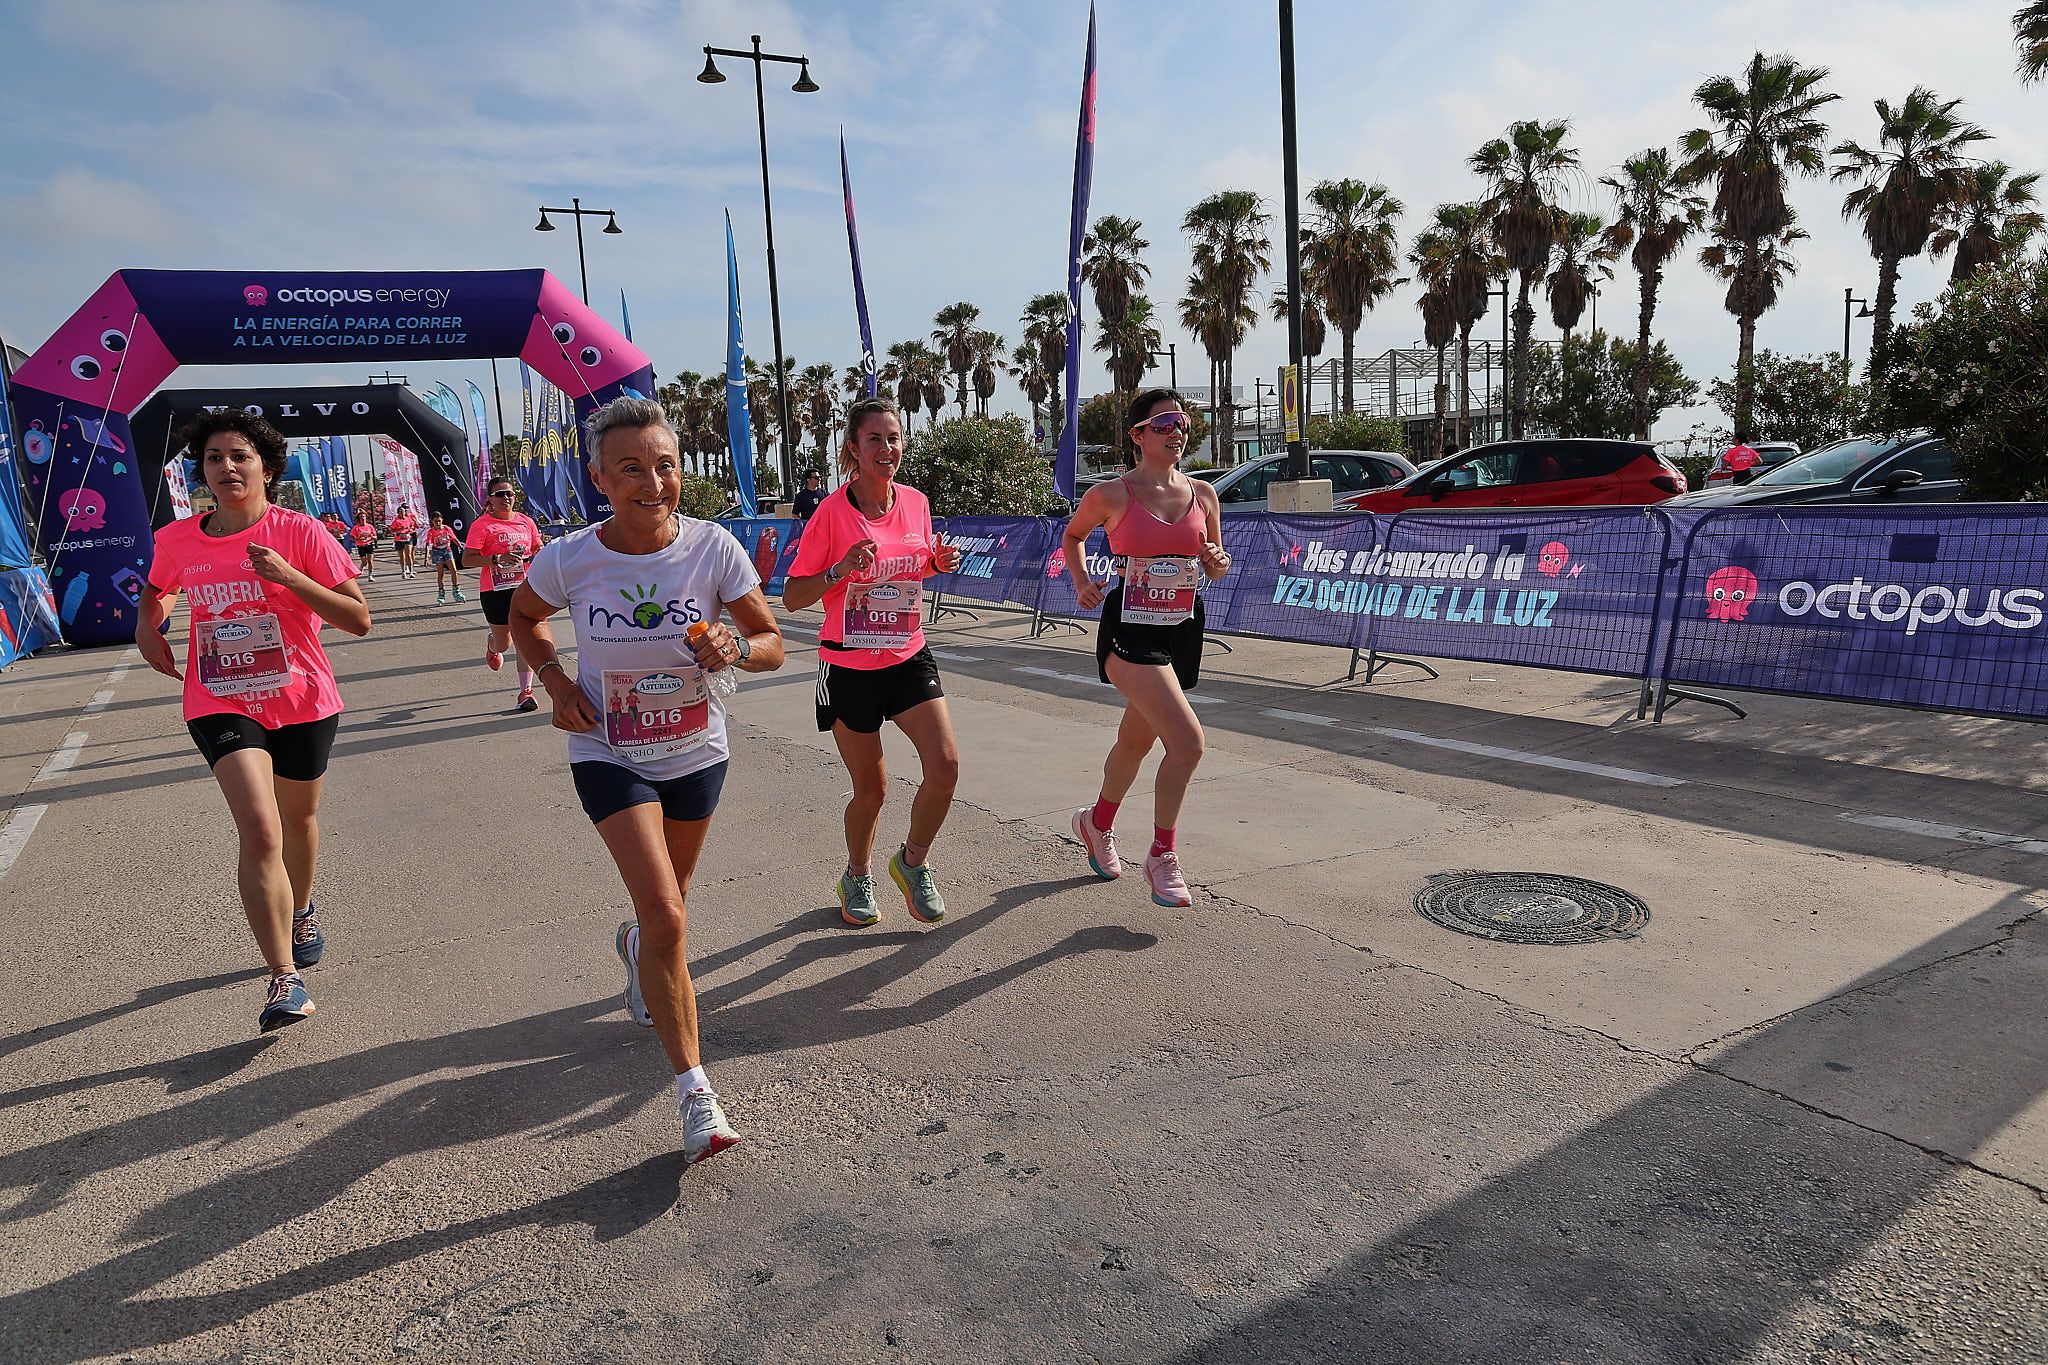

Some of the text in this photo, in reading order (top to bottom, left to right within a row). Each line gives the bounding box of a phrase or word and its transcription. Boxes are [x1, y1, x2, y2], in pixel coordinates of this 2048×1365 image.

[277, 287, 451, 308] octopus energy
[233, 315, 462, 330] LA ENERGÍA PARA CORRER
[233, 333, 468, 346] A LA VELOCIDAD DE LA LUZ
[50, 535, 136, 552] octopus energy
[861, 554, 922, 579] ARRERA
[957, 554, 998, 579] FINAL
[1303, 541, 1527, 581] Has alcanzado la
[1148, 588, 1177, 600] 016
[1271, 574, 1560, 628] VELOCIDAD DE LA LUZ
[589, 598, 702, 630] moss
[1779, 577, 2045, 637] octopus
[868, 610, 898, 623] 016
[1129, 613, 1154, 621] OYSHO
[216, 629, 251, 638] ASTURIANA
[590, 632, 688, 643] RESPONSABILIDAD COMPARTIDA
[220, 652, 256, 668] 016
[256, 669, 280, 677] VALENCIA
[209, 678, 281, 692] OYSHO Santander
[639, 681, 681, 691] ASTURIANA
[641, 708, 682, 727] 016
[617, 738, 643, 747] CARRERA
[651, 735, 659, 743] LA
[680, 726, 701, 738] VALENCIA
[622, 737, 701, 759] OYSHO Santander
